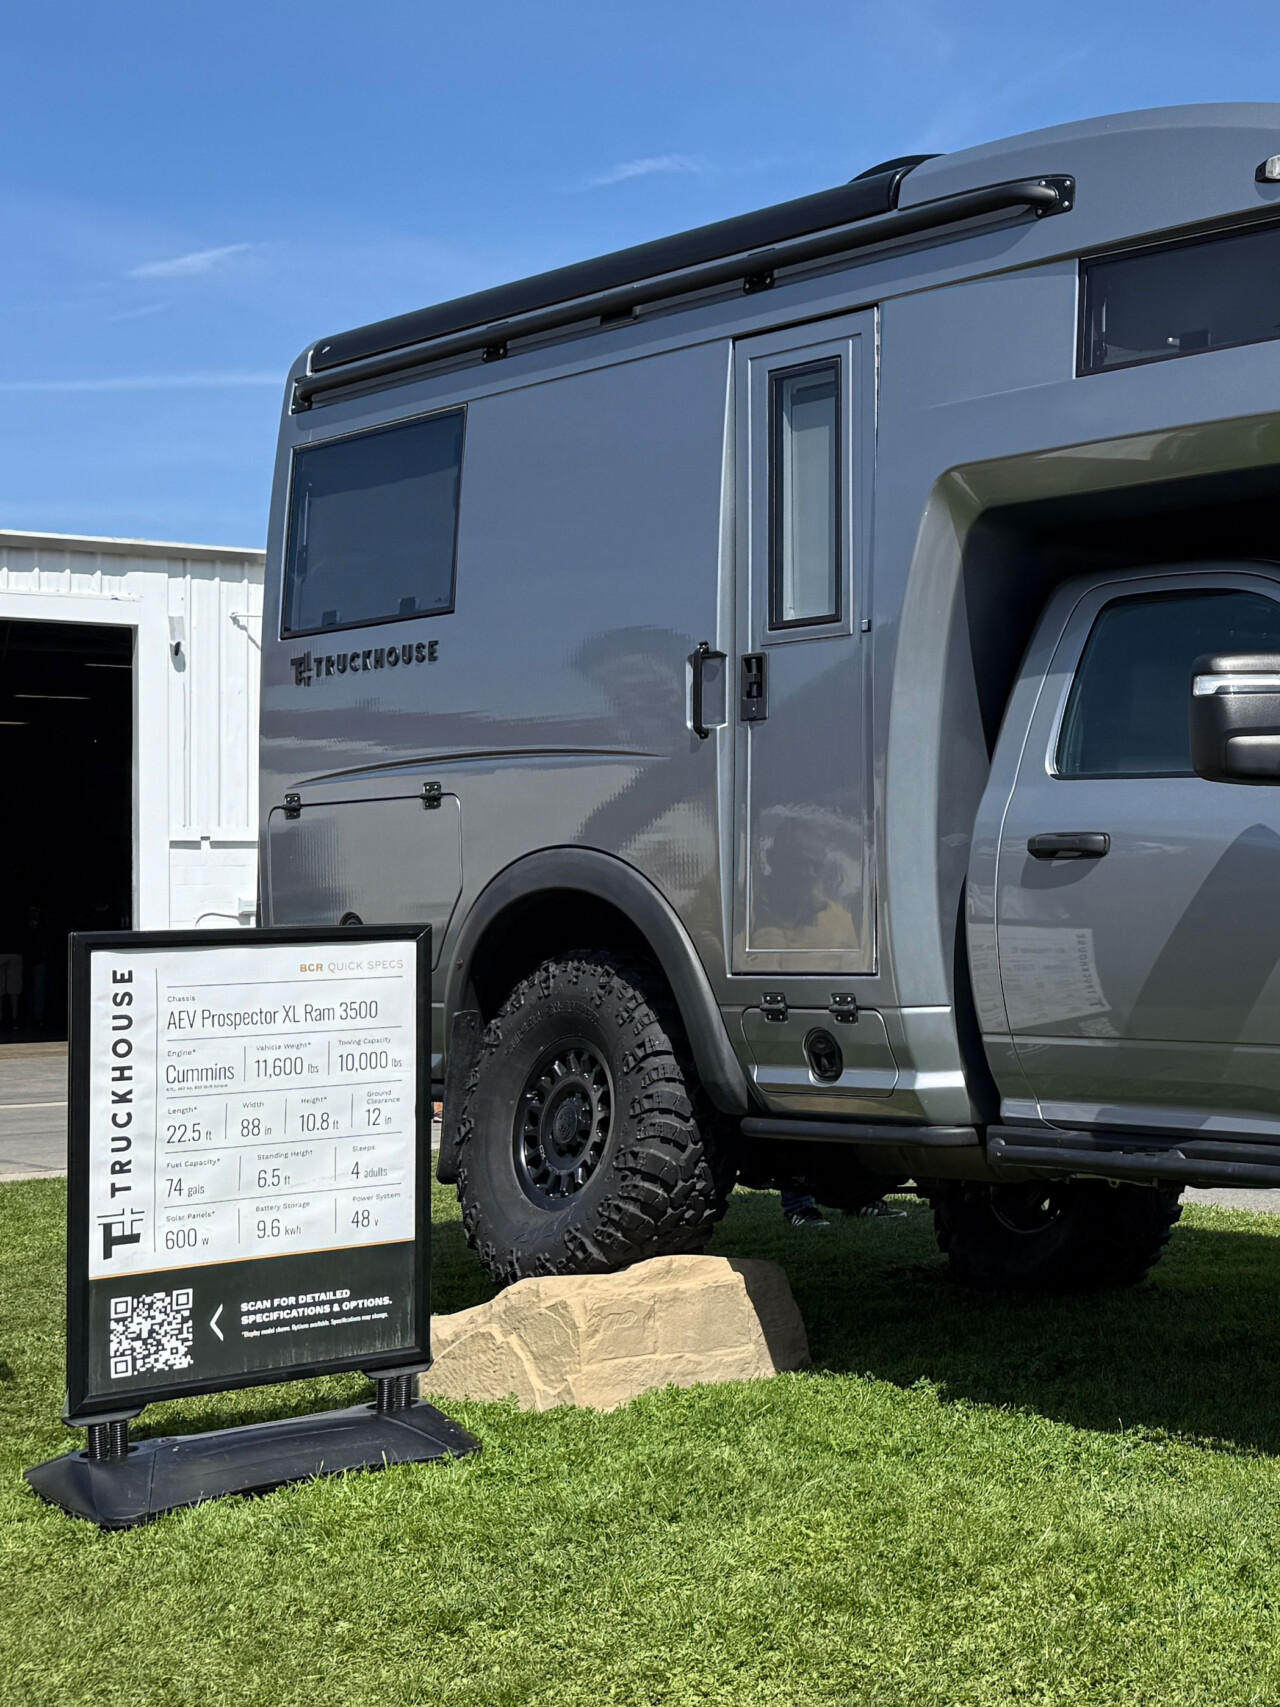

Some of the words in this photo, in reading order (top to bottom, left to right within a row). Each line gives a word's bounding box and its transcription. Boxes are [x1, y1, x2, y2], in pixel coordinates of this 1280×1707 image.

[313, 640, 439, 678] TRUCKHOUSE
[300, 963, 323, 972] BCR
[328, 961, 363, 973] QUICK
[367, 960, 403, 970] SPECS
[167, 995, 196, 1003] Chassis
[167, 1009, 197, 1030] AEV
[202, 1007, 279, 1031] Prospector
[282, 1004, 300, 1024] XL
[304, 1003, 335, 1023] Ram
[340, 1000, 378, 1020] 3500
[256, 1044, 281, 1052] Vehicle
[338, 1038, 361, 1048] Towing
[363, 1036, 392, 1045] Capacity
[254, 1056, 304, 1080] 11,600
[308, 1063, 319, 1074] lbs
[338, 1050, 388, 1073] 10,000
[391, 1057, 402, 1068] lbs
[166, 1062, 235, 1085] Cummins
[111, 969, 134, 1199] TRUCKHOUSE
[367, 1089, 392, 1097] Ground
[242, 1101, 265, 1109] Width
[367, 1096, 401, 1105] Clearance
[299, 1111, 330, 1133] 10.8
[333, 1120, 339, 1130] ft
[365, 1107, 381, 1127] 12
[384, 1115, 392, 1126] in
[166, 1122, 201, 1144] 22.5
[205, 1130, 212, 1141] ft
[241, 1117, 261, 1138] 88
[264, 1126, 272, 1136] in
[257, 1151, 289, 1160] Standing
[291, 1149, 313, 1159] Height
[352, 1144, 375, 1153] Sleeps
[167, 1161, 182, 1169] Fuel
[351, 1161, 361, 1180] 4
[363, 1167, 388, 1179] adults
[166, 1177, 184, 1198] 74
[187, 1184, 205, 1198] gals
[257, 1167, 281, 1189] 6.5
[284, 1175, 291, 1185] ft
[256, 1203, 281, 1213] Battery
[282, 1201, 311, 1210] Storage
[352, 1195, 374, 1203] Power
[375, 1192, 401, 1201] System
[166, 1214, 185, 1223] Solar
[351, 1209, 371, 1229] 48
[165, 1227, 198, 1250] 600
[257, 1218, 281, 1240] 9.6
[284, 1225, 301, 1237] kwh
[240, 1298, 271, 1312] SCAN
[273, 1296, 296, 1308] FOR
[298, 1289, 351, 1305] DETAILED
[241, 1301, 331, 1325] SPECIFICATIONS
[333, 1302, 340, 1312] &
[342, 1296, 393, 1311] OPTIONS.
